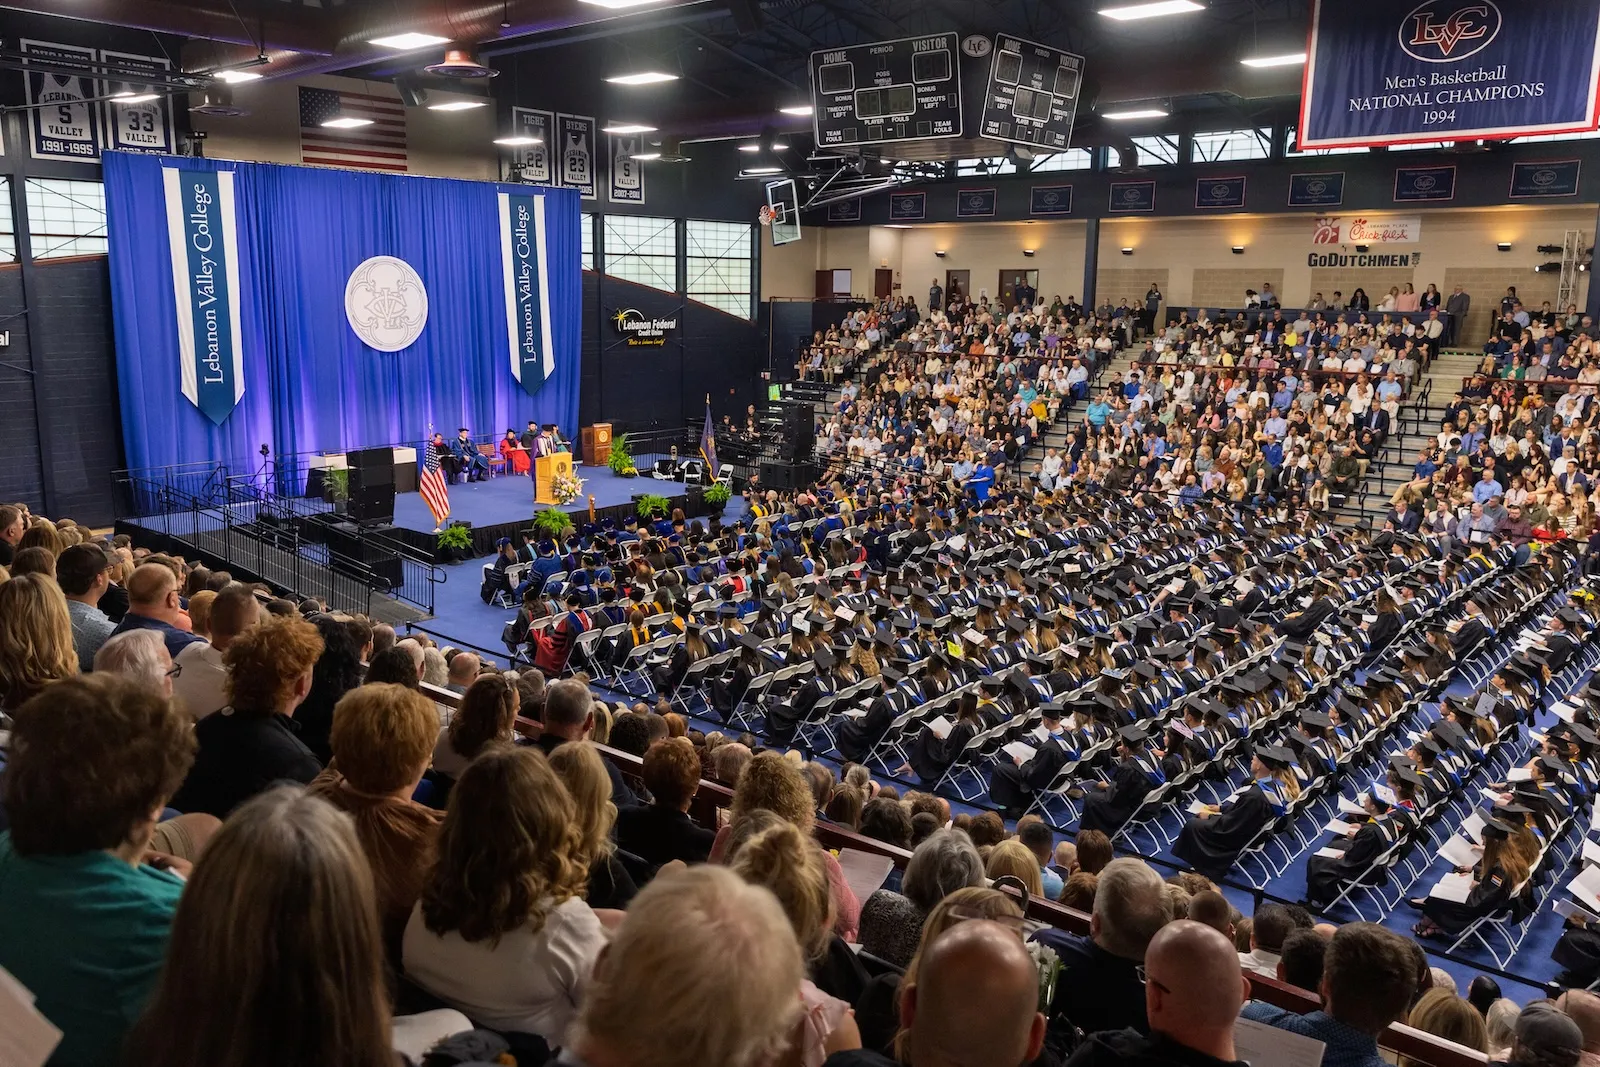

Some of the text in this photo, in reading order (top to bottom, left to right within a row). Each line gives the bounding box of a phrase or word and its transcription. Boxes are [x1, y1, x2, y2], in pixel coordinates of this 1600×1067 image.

[1410, 6, 1488, 56] LVC
[870, 45, 894, 55] PERIOD
[913, 37, 947, 52] VISITOR
[968, 39, 986, 54] LVC
[1004, 38, 1021, 53] HOME
[823, 51, 847, 64] HOME
[1060, 54, 1079, 69] VISITOR
[1385, 65, 1507, 90] Men's Basketball
[917, 95, 946, 104] TIMEOUTS
[924, 101, 939, 109] LEFT
[1349, 83, 1545, 112] NATIONAL CHAMPIONS
[59, 106, 72, 124] 5
[128, 111, 154, 132] 33
[523, 115, 545, 126] TIGHE
[1422, 109, 1456, 125] 1994
[48, 125, 83, 137] VALLEY
[566, 120, 587, 131] BYERS
[125, 133, 157, 144] VALLEY
[41, 140, 94, 155] 1991-1995
[527, 152, 542, 168] 22
[569, 157, 585, 173] 23
[525, 169, 545, 177] VALLEY
[568, 173, 586, 181] VALLEY
[624, 163, 630, 176] 5
[618, 178, 635, 186] VALLEY
[614, 189, 640, 199] 2007-2011
[1349, 219, 1409, 242] Chick-fil-A
[190, 184, 224, 384] Lebanon Valley College
[515, 205, 537, 364] Lebanon Valley College
[623, 319, 676, 330] Lebanon Federal
